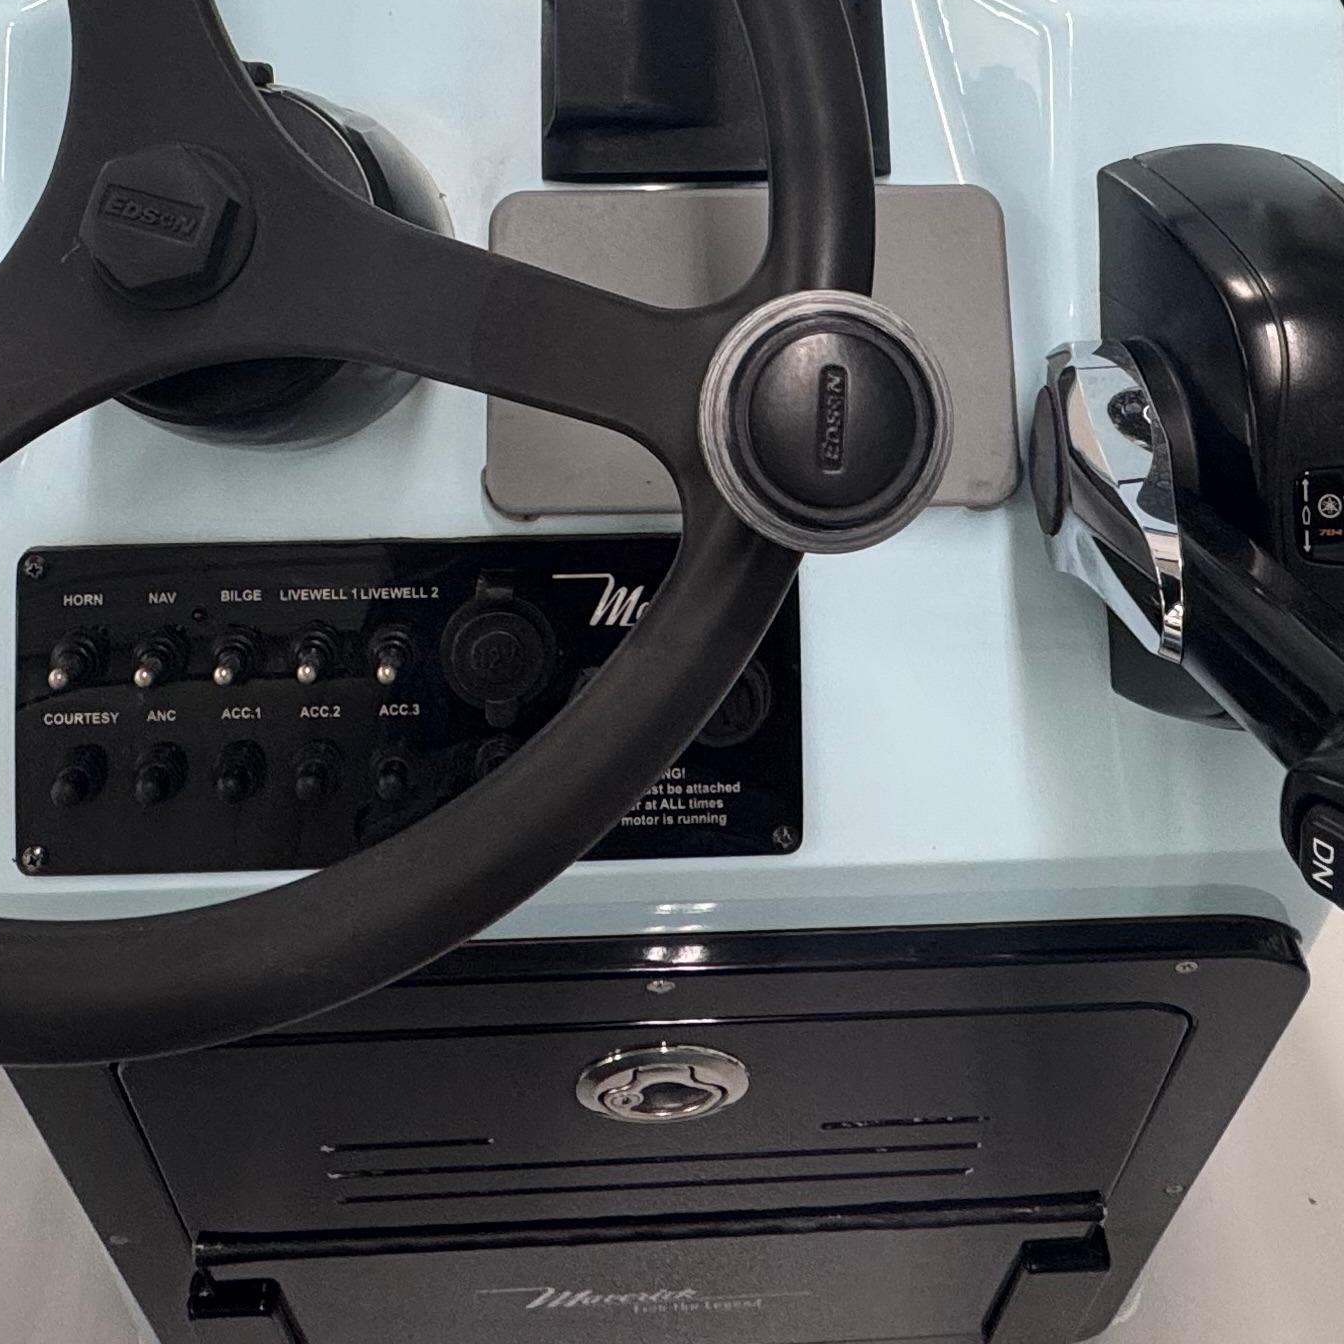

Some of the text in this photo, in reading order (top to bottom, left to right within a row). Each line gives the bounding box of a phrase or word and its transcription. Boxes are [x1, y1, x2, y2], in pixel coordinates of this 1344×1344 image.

[106, 191, 199, 237] EDSON
[148, 592, 177, 604] NAV
[220, 589, 262, 602] BILGE
[280, 587, 358, 601] LIVEWELL 1
[360, 586, 439, 599] LIVEWELL 2
[63, 593, 103, 606] HORN
[146, 710, 177, 722] ANC
[221, 707, 262, 720] ACC.1
[300, 705, 341, 718] ACC.2
[378, 704, 420, 717] ACC.3
[43, 712, 120, 726] COURTESY
[667, 783, 683, 795] be
[686, 781, 741, 795] attached
[644, 799, 657, 811] at
[660, 798, 686, 809] ALL
[689, 797, 724, 809] times
[621, 812, 727, 826] motor is running
[1312, 836, 1335, 890] DN
